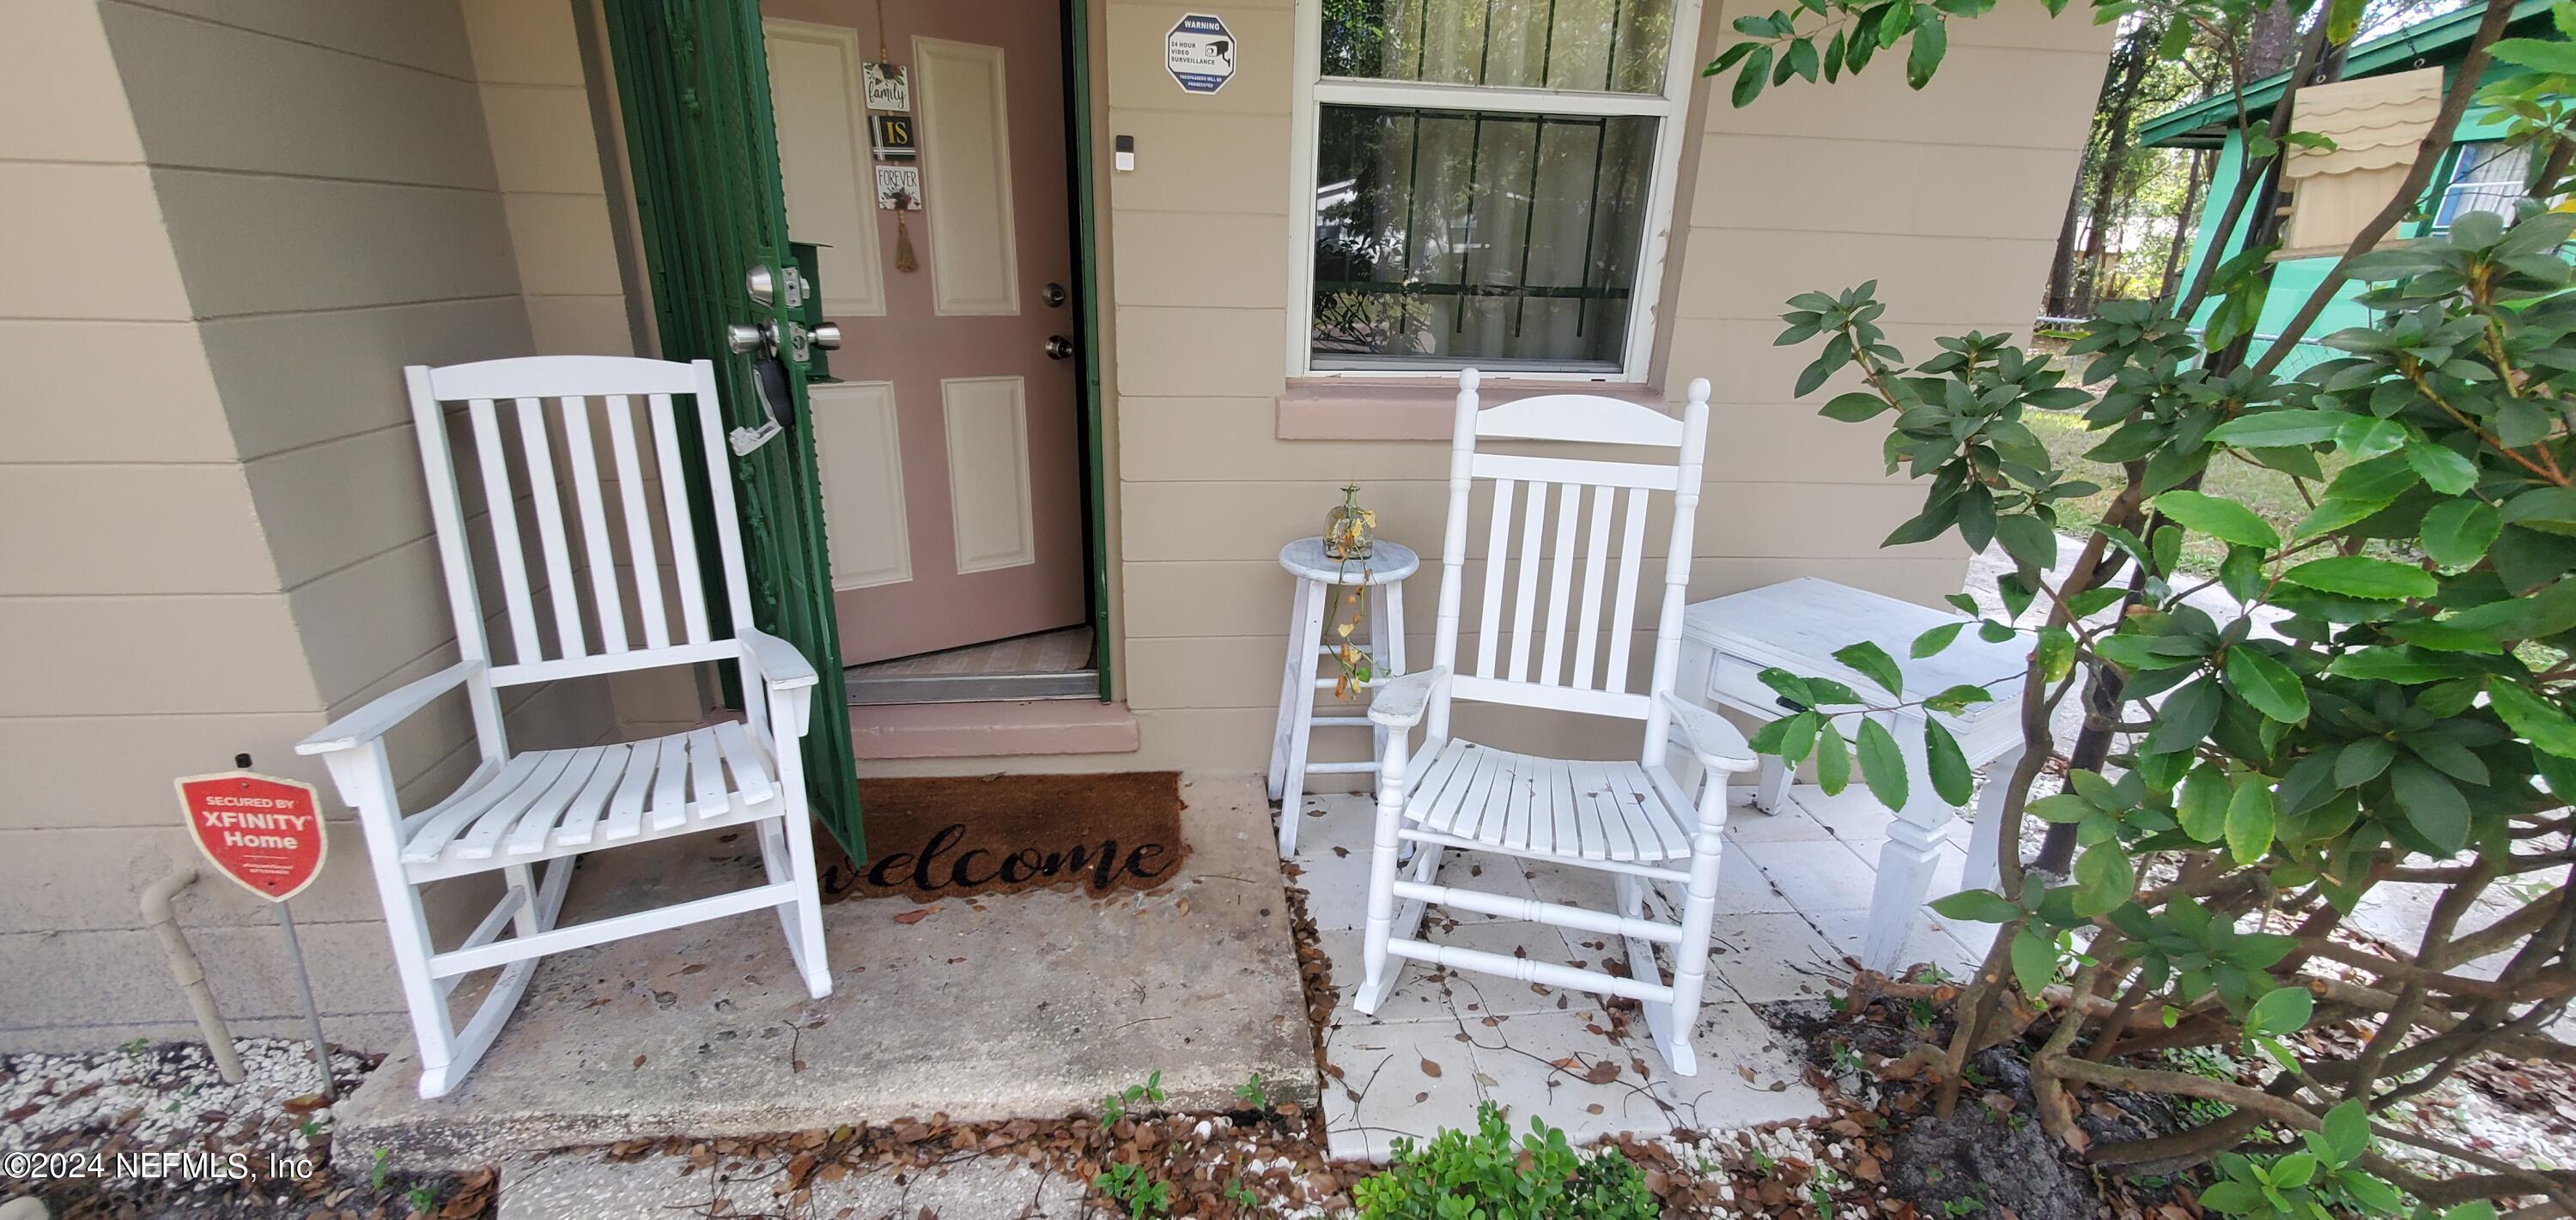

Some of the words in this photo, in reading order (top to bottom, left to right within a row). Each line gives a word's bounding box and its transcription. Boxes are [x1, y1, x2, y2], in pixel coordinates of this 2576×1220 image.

[1185, 20, 1219, 30] WARNING
[868, 81, 904, 109] family
[886, 121, 908, 144] IS
[878, 169, 918, 187] FOREVER
[205, 796, 273, 808] SECURED
[275, 798, 295, 809] BY
[223, 831, 299, 849] Home
